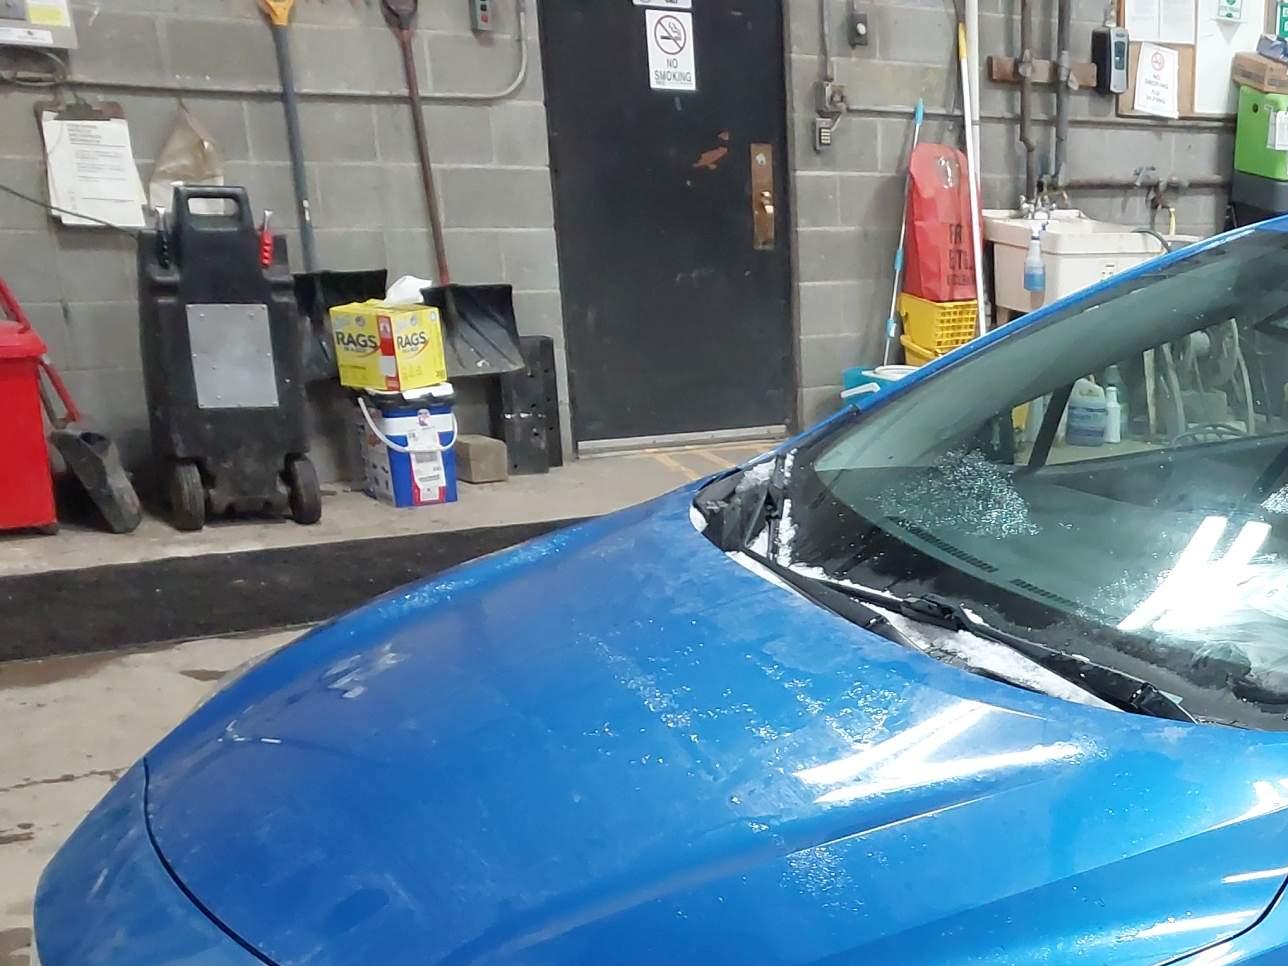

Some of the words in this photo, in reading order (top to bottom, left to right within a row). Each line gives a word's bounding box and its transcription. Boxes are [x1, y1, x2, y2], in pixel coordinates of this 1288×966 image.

[666, 58, 679, 69] NO
[654, 70, 692, 82] SMOKING
[336, 332, 378, 349] RAGS
[397, 331, 426, 350] RAGS
